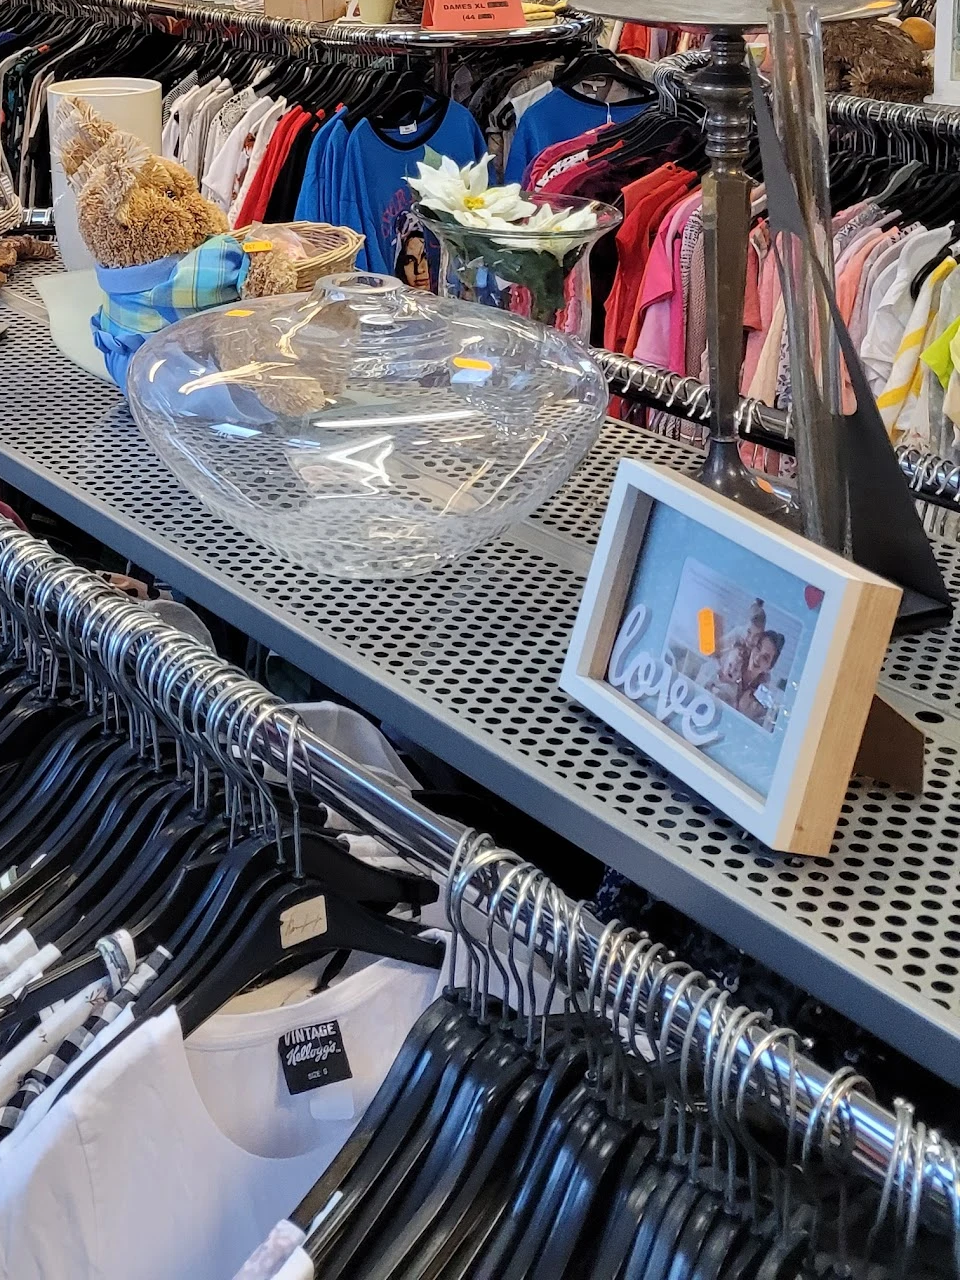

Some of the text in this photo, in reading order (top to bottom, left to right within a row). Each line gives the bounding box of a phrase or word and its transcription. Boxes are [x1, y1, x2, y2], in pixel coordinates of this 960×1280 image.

[608, 604, 719, 746] love
[284, 1023, 337, 1046] VINTAGE
[285, 1040, 337, 1066] Kellogg's
